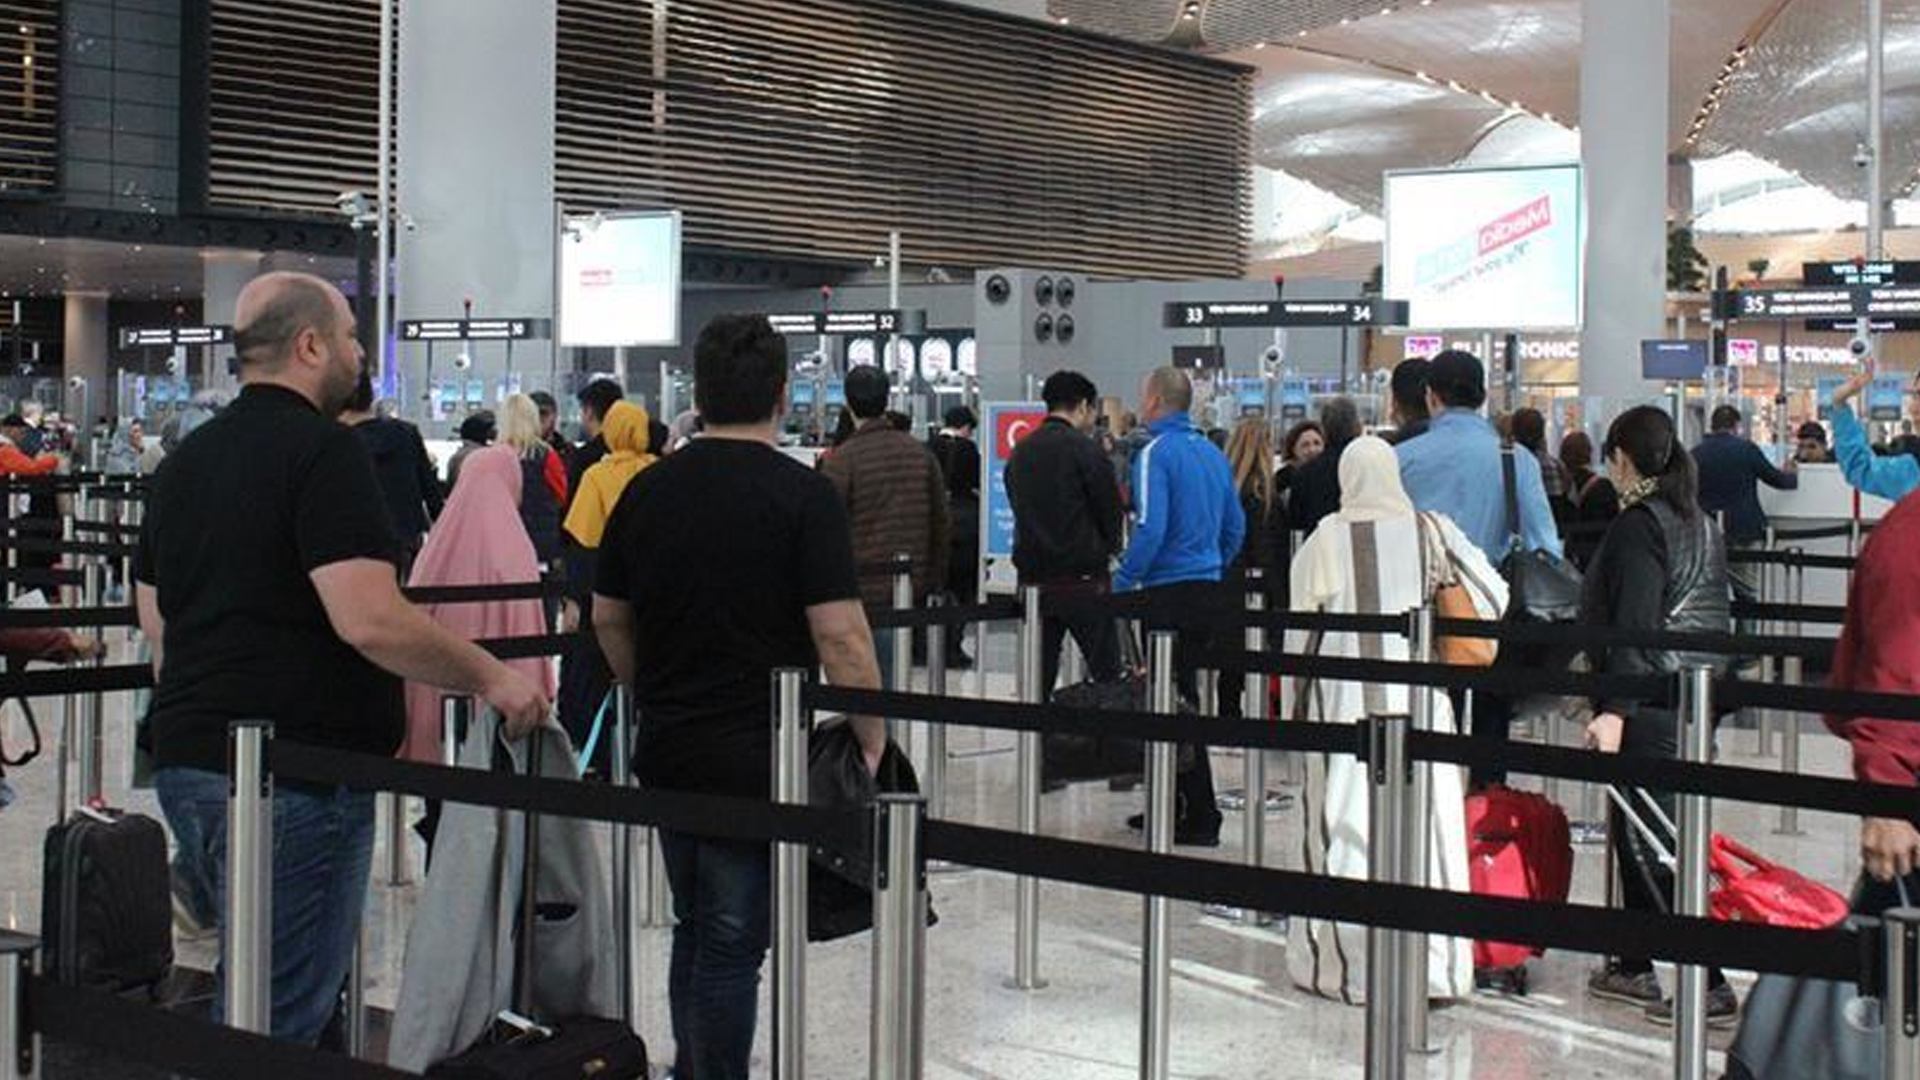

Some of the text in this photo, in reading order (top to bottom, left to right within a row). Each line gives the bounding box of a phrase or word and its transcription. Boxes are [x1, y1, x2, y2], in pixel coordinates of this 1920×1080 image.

[1744, 296, 1765, 313] 35
[1186, 308, 1203, 323] 33
[1353, 306, 1371, 321] 34
[880, 314, 895, 329] 32
